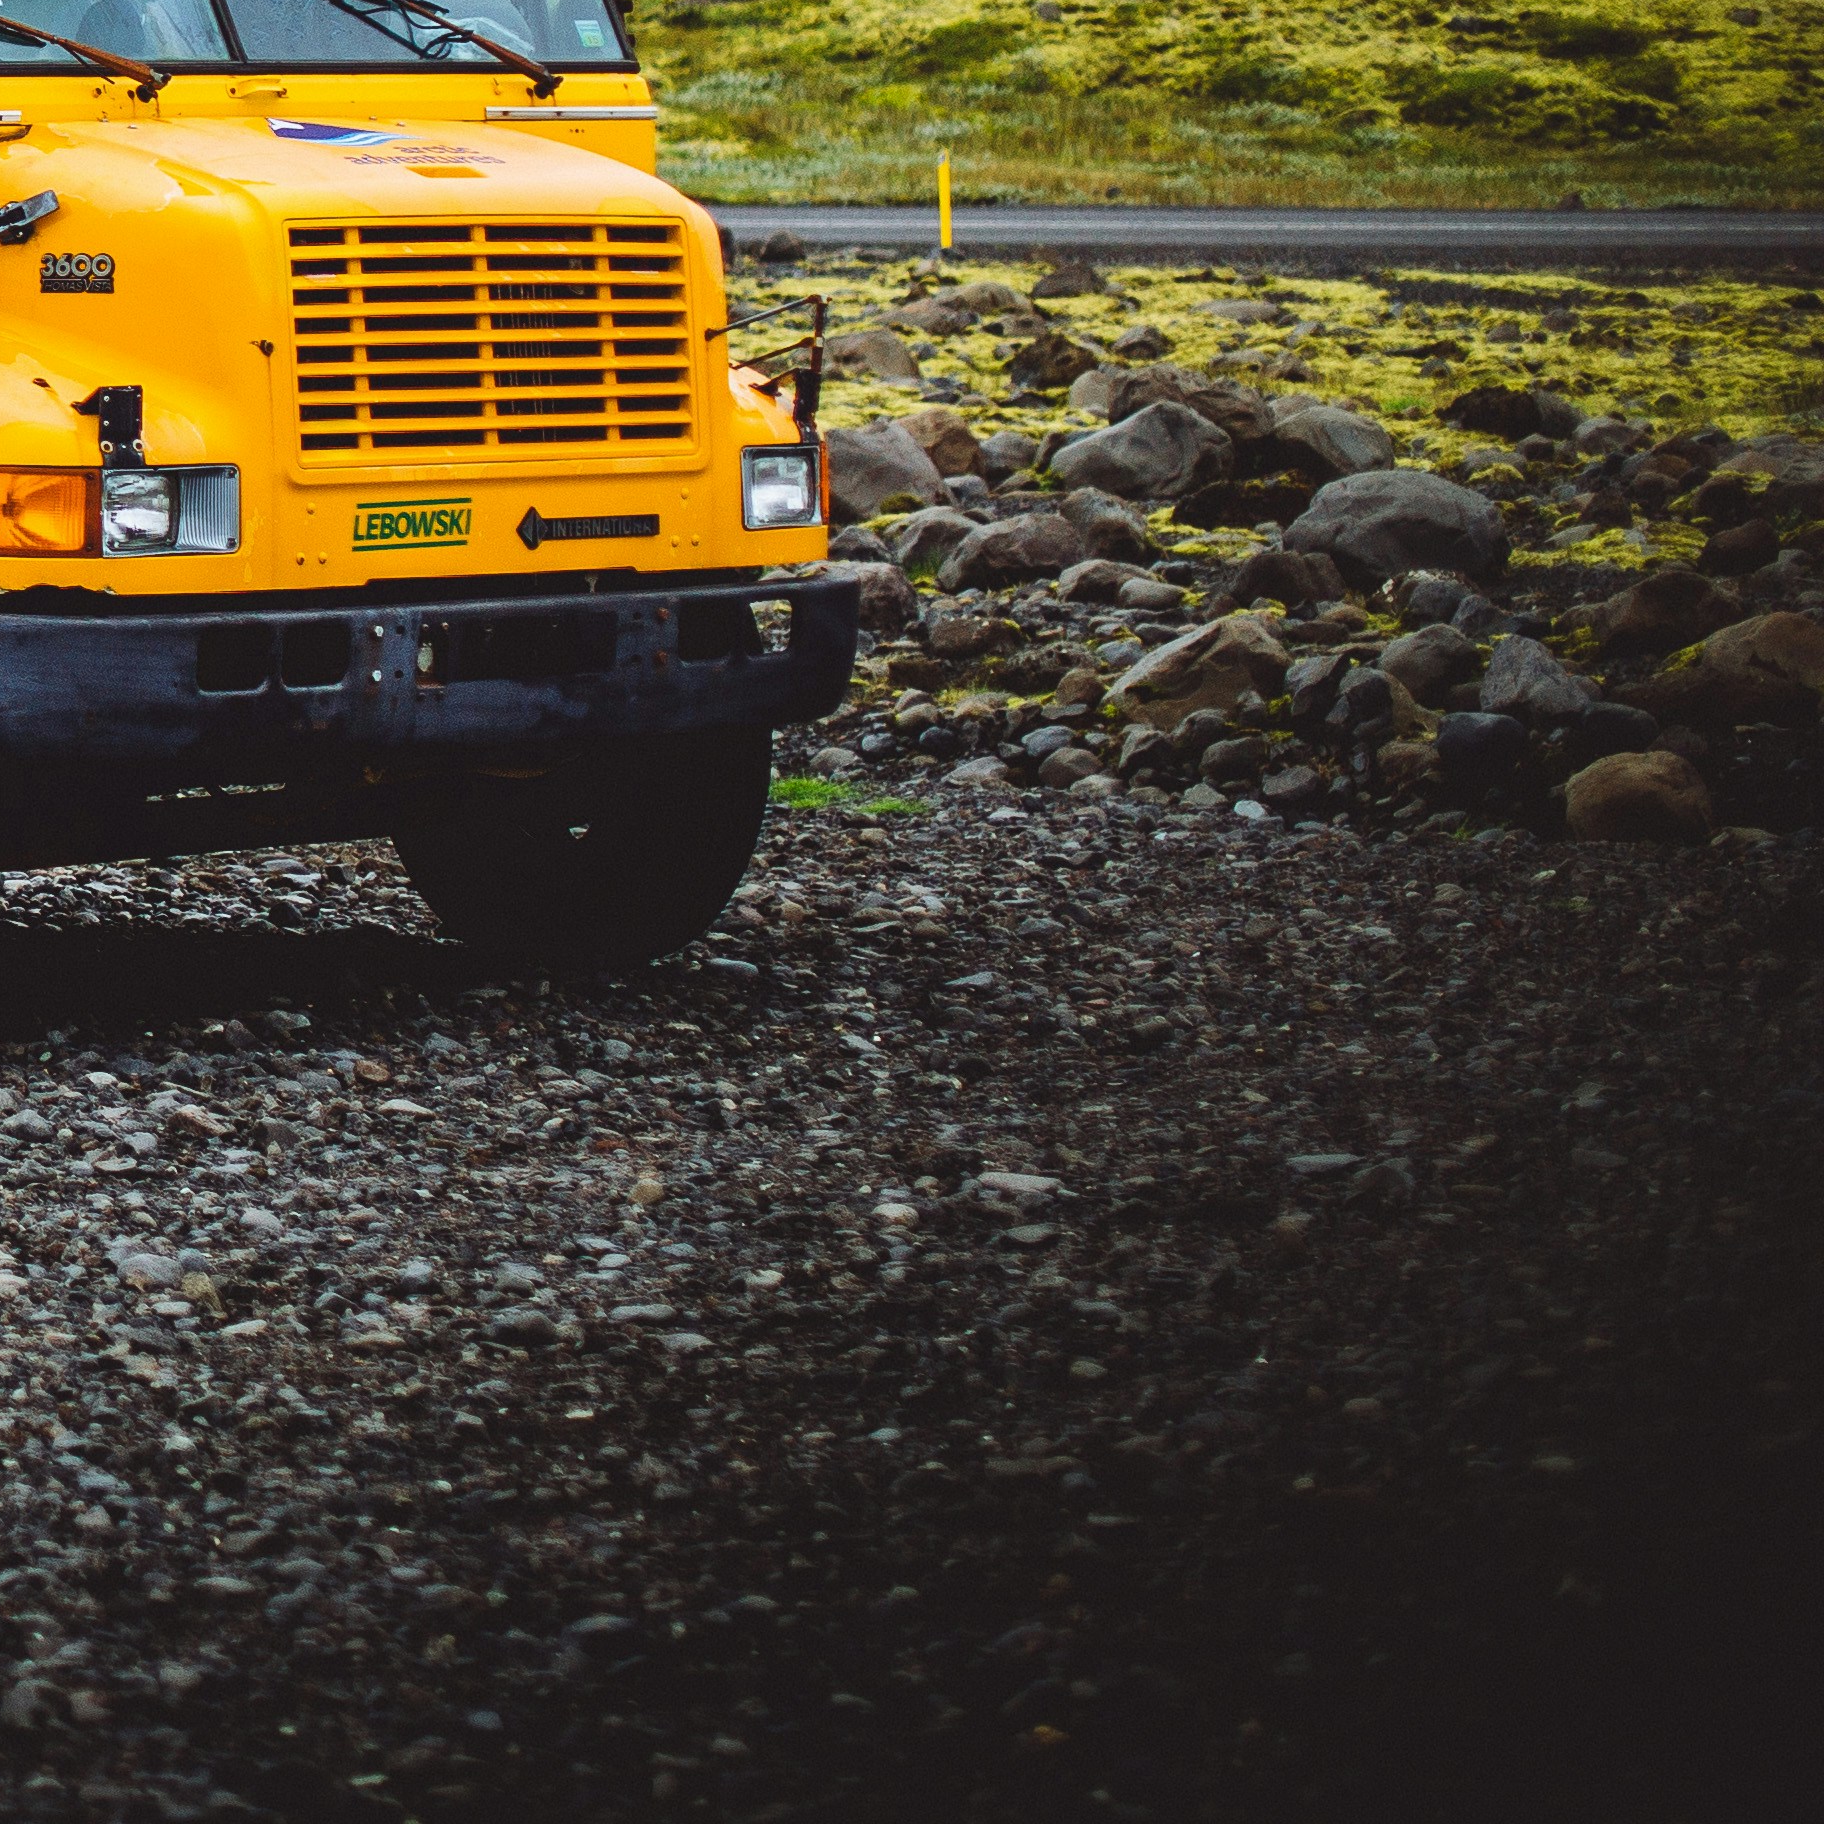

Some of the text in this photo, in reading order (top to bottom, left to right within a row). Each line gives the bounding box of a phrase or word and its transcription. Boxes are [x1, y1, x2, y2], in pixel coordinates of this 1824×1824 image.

[41, 254, 113, 277] 3600
[353, 508, 472, 541] LEBOWSKI
[552, 513, 657, 538] INTERNATIONA
